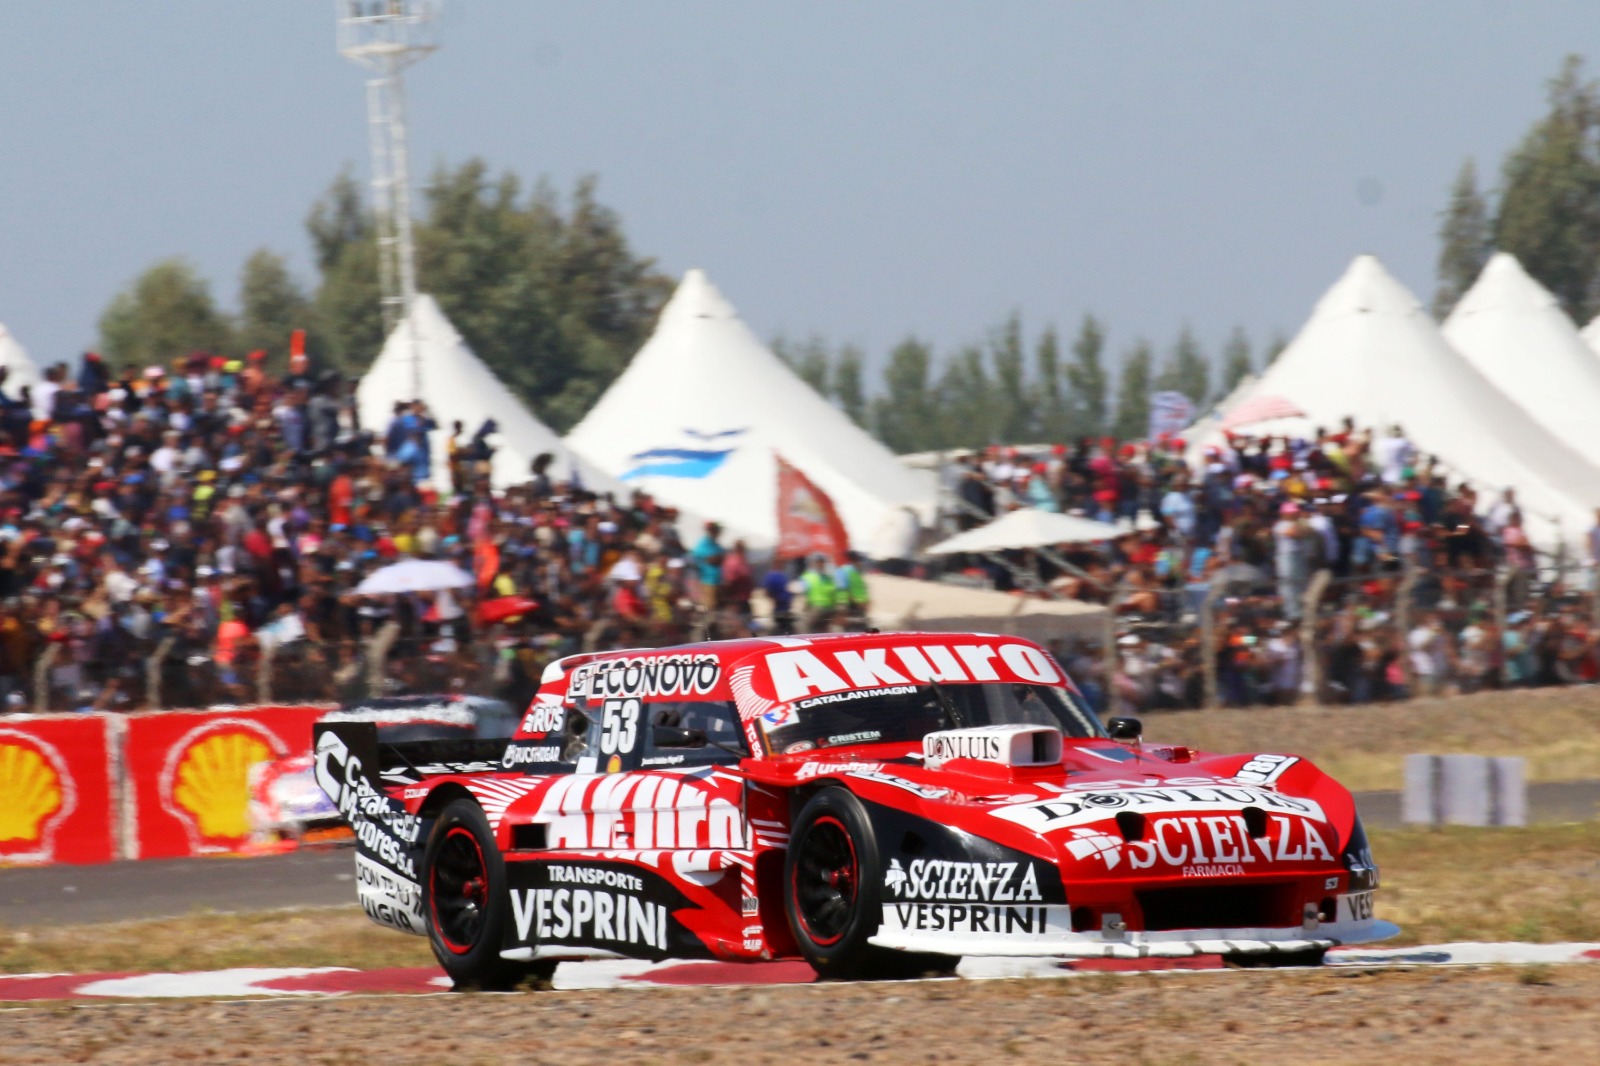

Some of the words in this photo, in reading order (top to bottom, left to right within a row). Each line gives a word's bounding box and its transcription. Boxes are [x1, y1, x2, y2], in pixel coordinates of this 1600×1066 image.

[590, 654, 720, 696] ECONOVO
[800, 689, 870, 709] CATALAN
[870, 686, 918, 698] MAGNI
[600, 699, 640, 755] 53
[828, 730, 882, 744] CRISTEM
[1128, 816, 1335, 870] SCIENZA
[547, 865, 643, 892] TRANSPORTE
[905, 861, 1043, 901] SCIENZA
[1182, 863, 1246, 878] FARMACIA
[510, 888, 668, 951] VESPRINI
[895, 905, 1047, 934] VESPRINI
